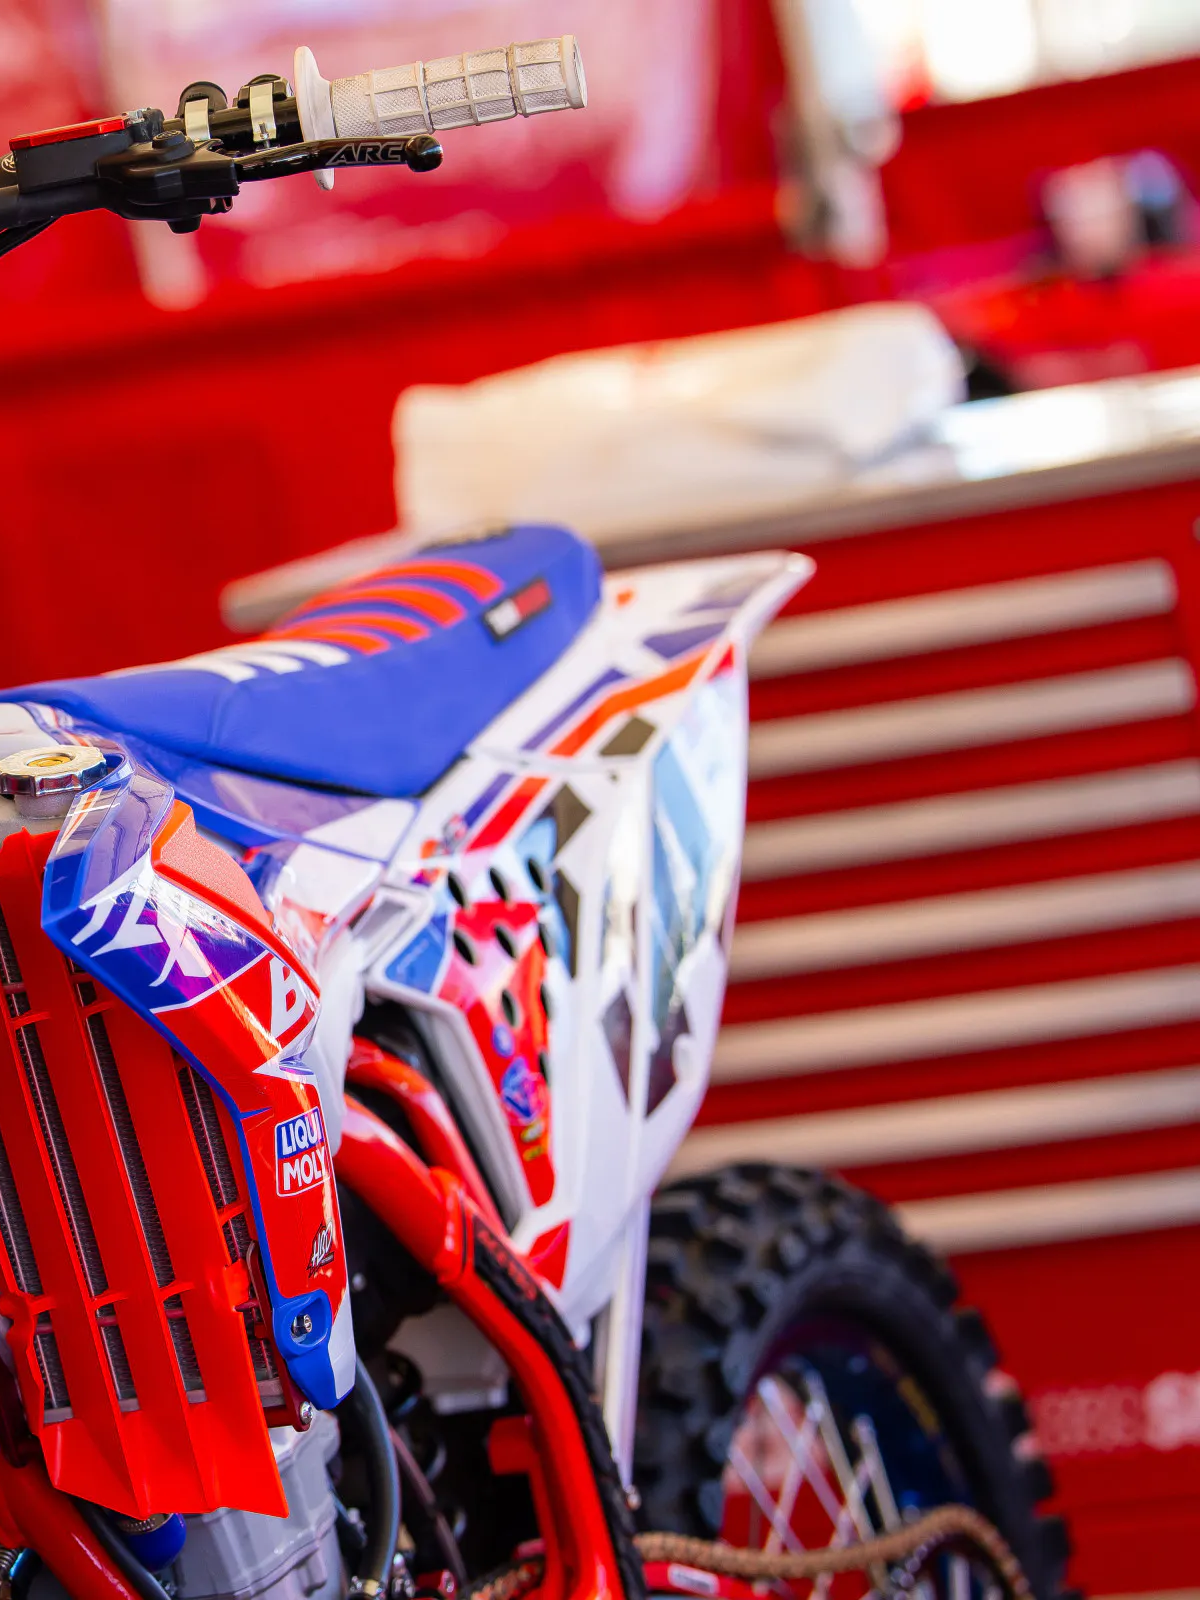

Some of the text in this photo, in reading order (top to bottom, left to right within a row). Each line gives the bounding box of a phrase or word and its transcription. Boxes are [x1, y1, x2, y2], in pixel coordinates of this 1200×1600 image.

[325, 141, 404, 166] ARC
[281, 1110, 323, 1156] LIQUI
[283, 1145, 328, 1191] MOLY
